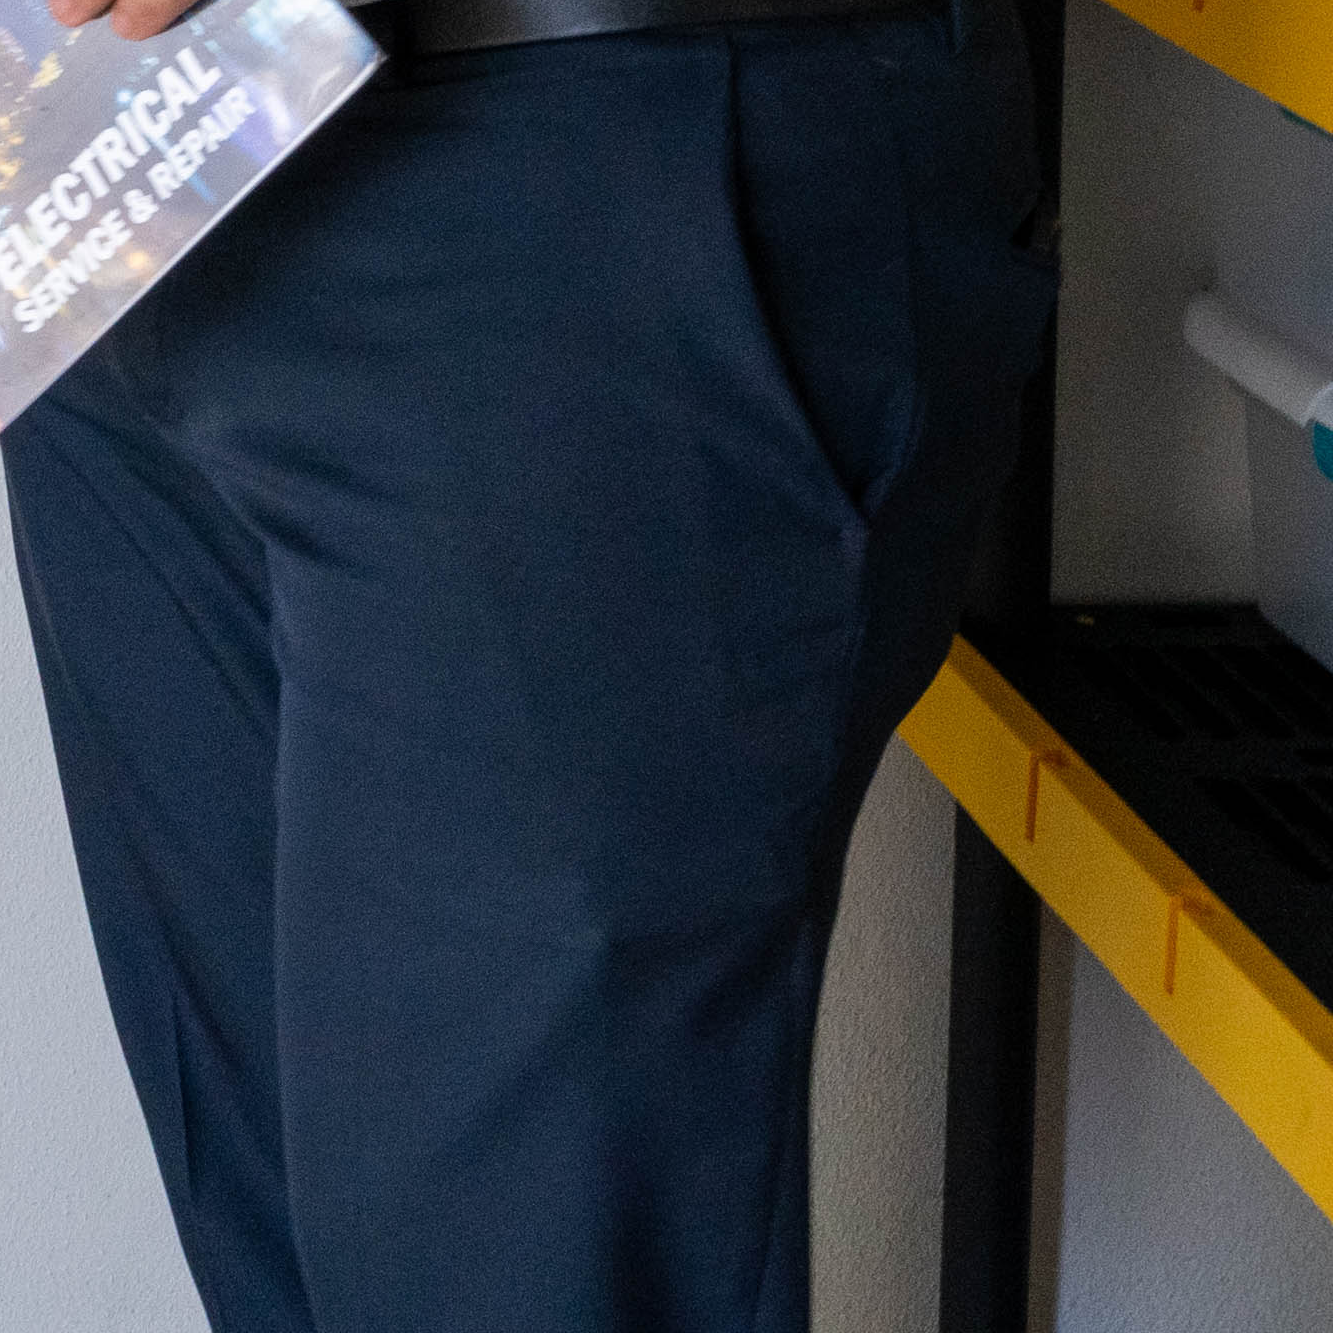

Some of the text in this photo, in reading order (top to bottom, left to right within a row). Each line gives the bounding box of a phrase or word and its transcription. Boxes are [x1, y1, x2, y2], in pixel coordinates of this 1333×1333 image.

[13, 85, 257, 333] SERVICE & REPAIR
